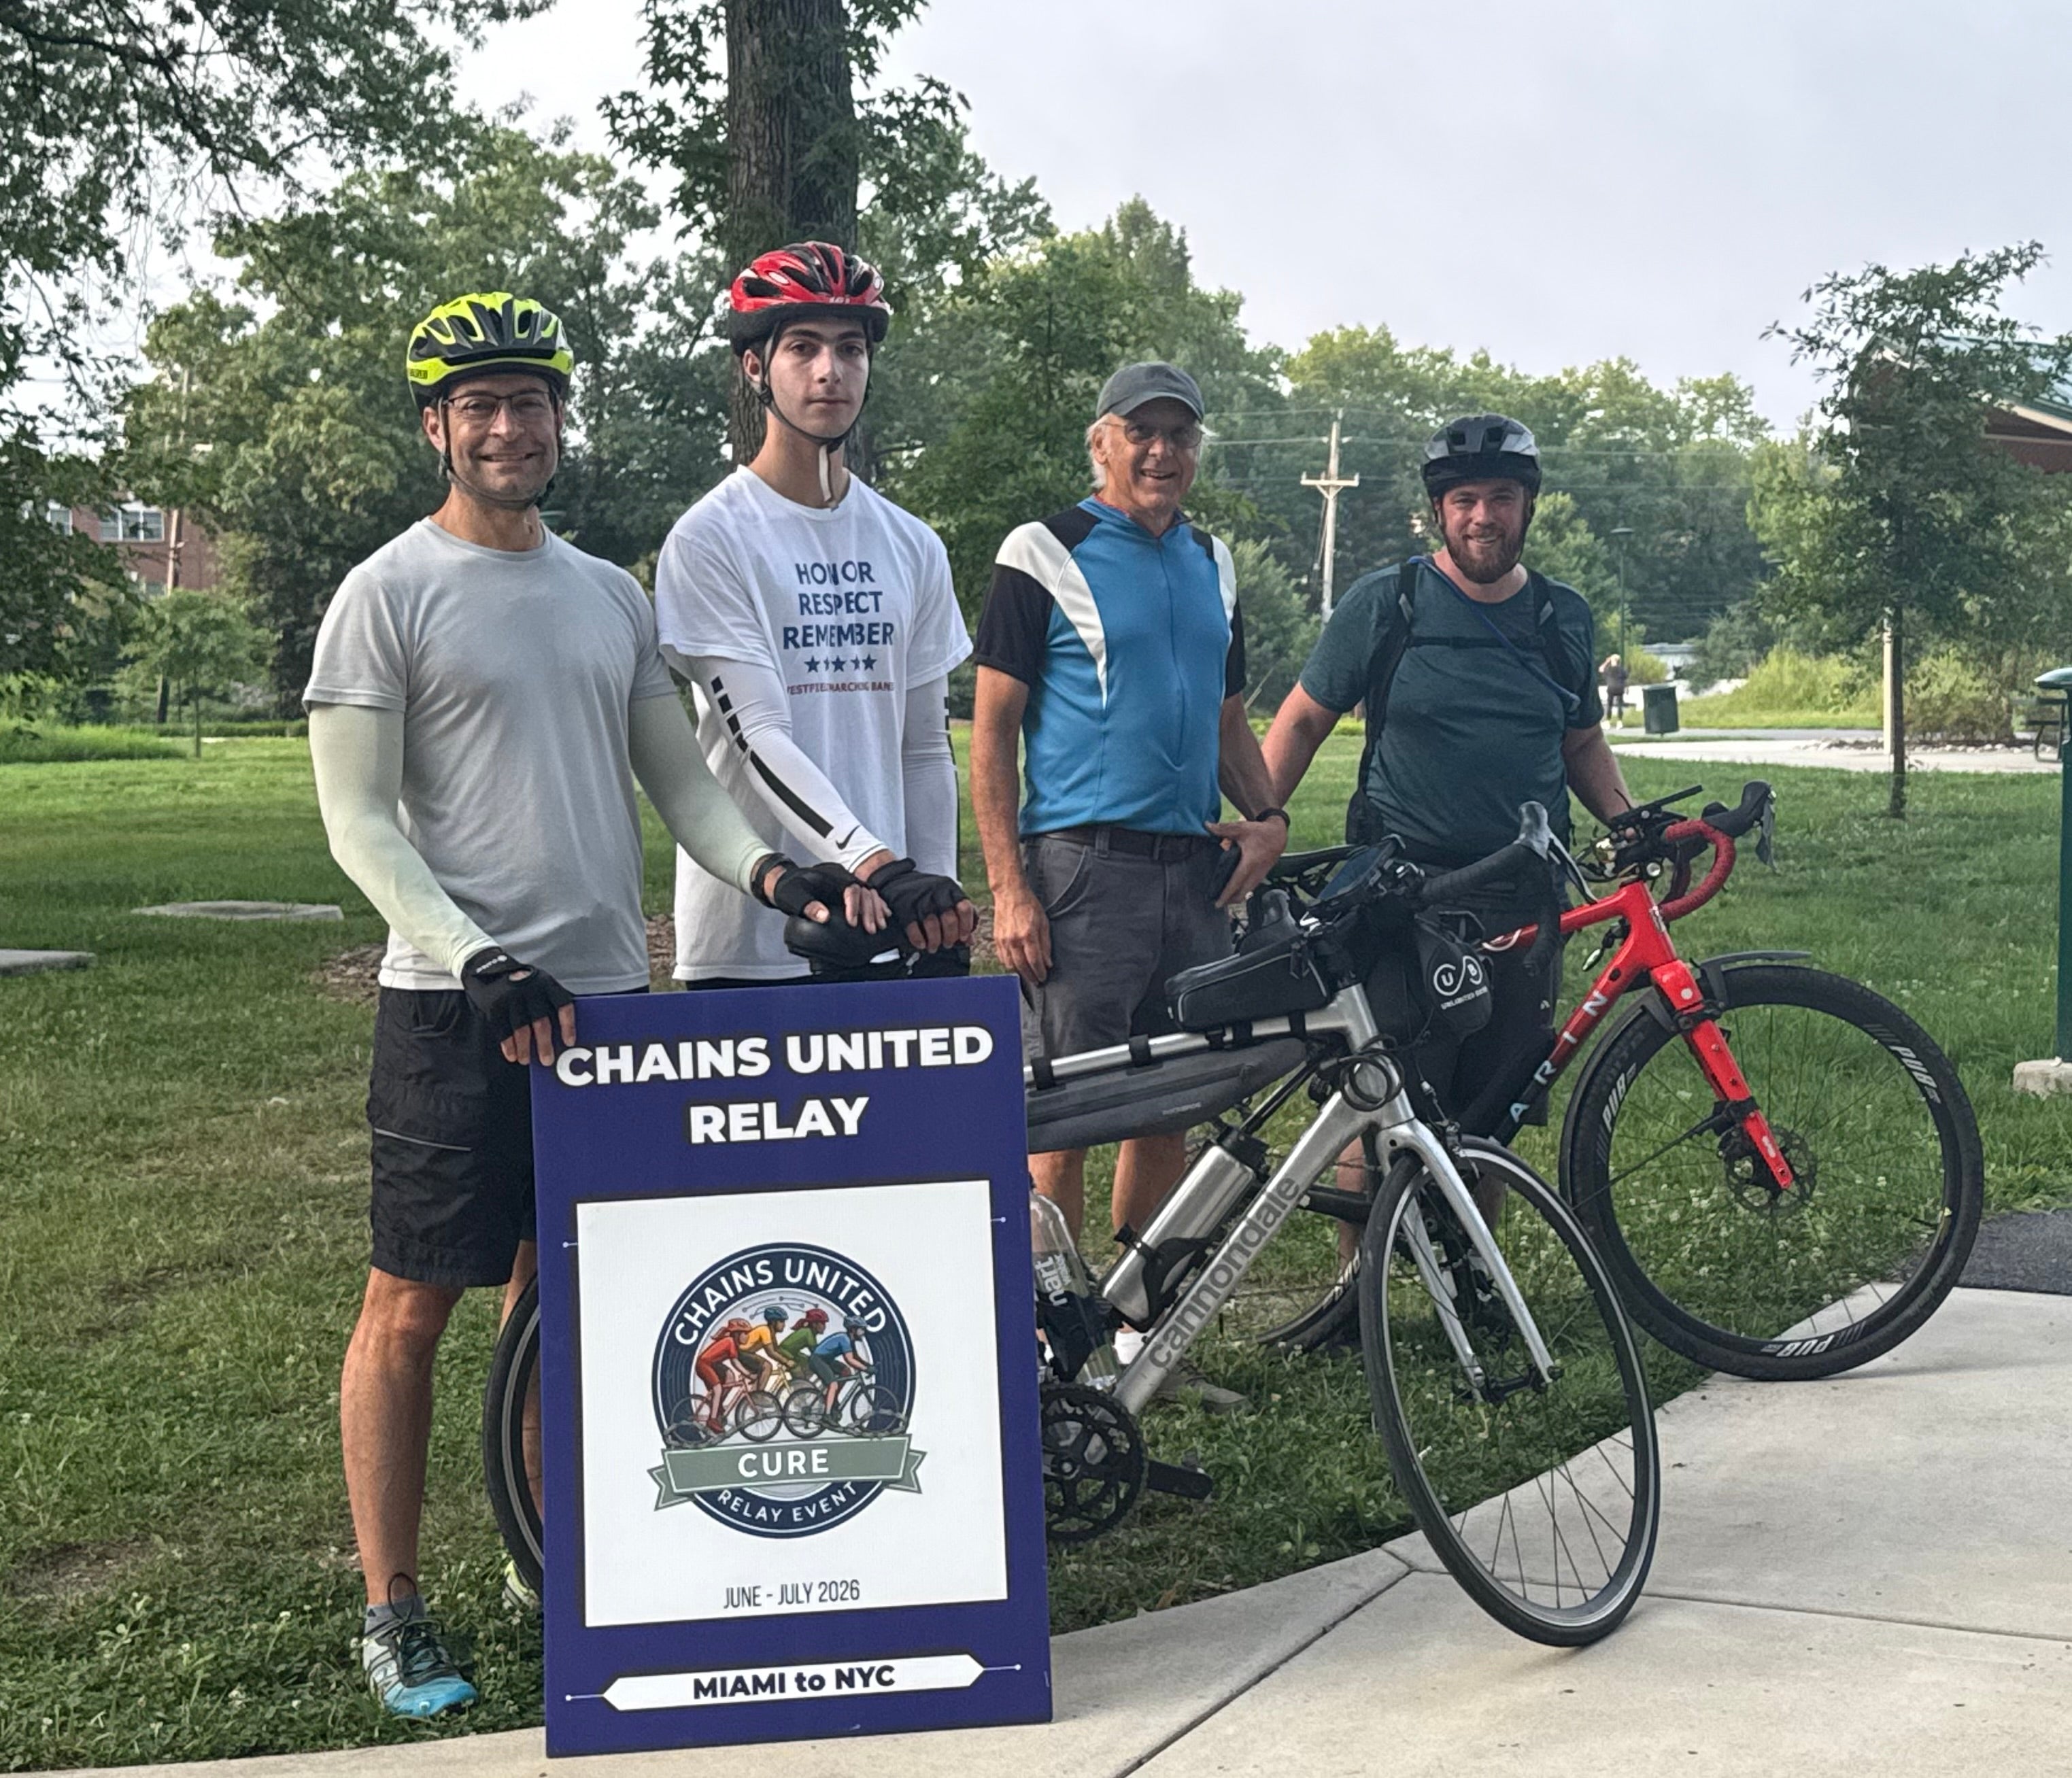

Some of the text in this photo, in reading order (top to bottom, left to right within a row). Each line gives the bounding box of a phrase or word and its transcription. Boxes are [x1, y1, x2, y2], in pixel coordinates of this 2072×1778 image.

[794, 560, 876, 586] HONOR
[798, 591, 883, 616] RESPECT
[783, 622, 895, 650] REMEMBER
[556, 1026, 993, 1087] CHAINS UNITED
[1489, 990, 1608, 1145] ARIN
[690, 1096, 869, 1144] RELAY
[1149, 1177, 1300, 1369] cannondale
[675, 1258, 887, 1346] CHAINS UNITED
[738, 1448, 830, 1479] CURE
[717, 1480, 858, 1523] RELAY EVENT
[723, 1584, 762, 1610] JUNE
[777, 1582, 813, 1606] JULY
[817, 1578, 860, 1603] 2026
[693, 1665, 896, 1700] MIAMI to NYC
